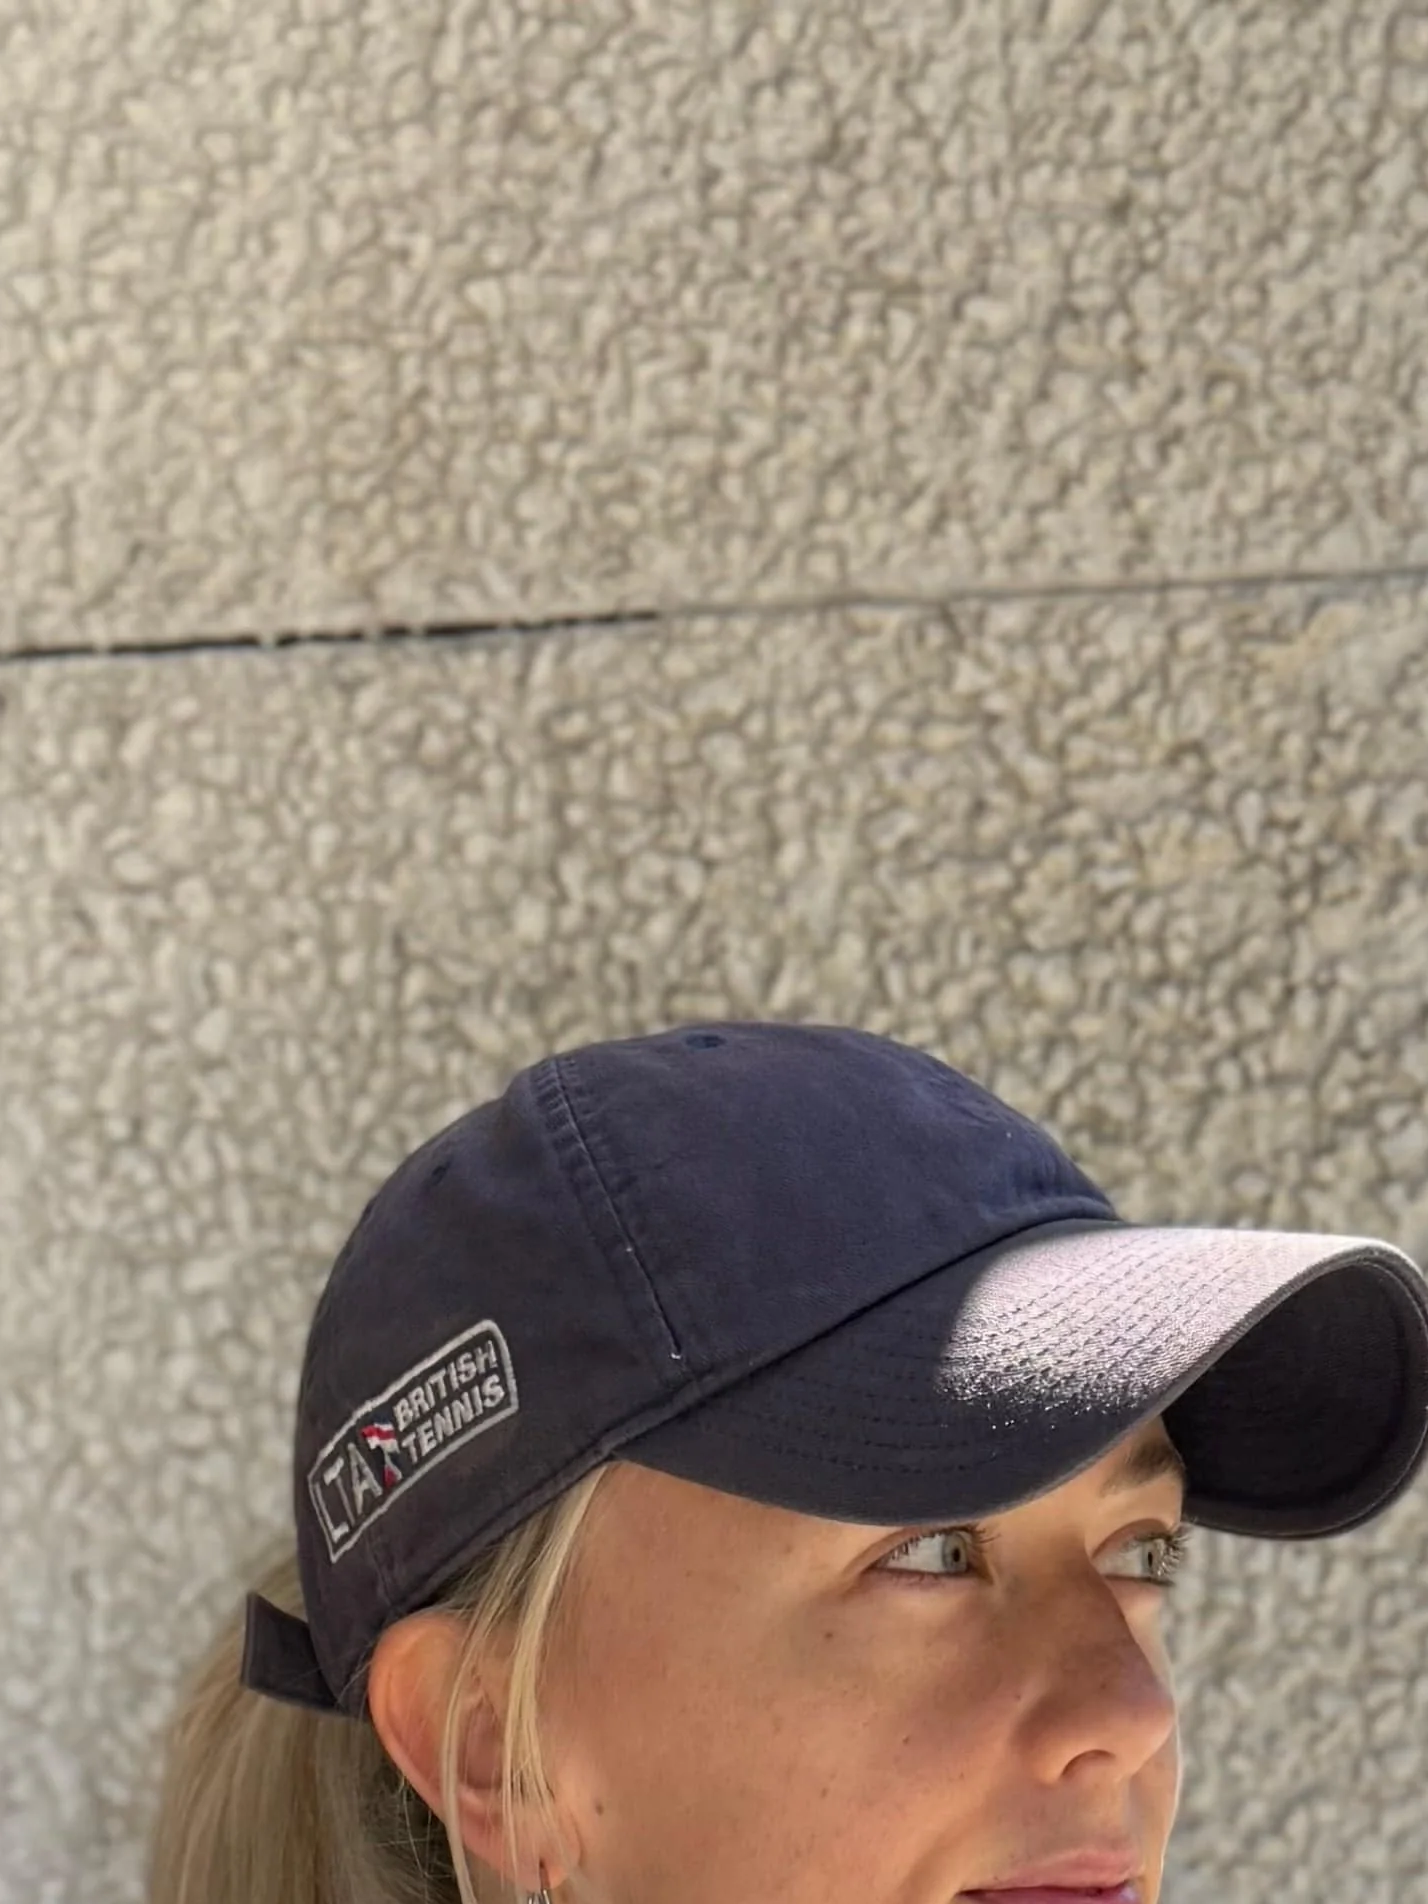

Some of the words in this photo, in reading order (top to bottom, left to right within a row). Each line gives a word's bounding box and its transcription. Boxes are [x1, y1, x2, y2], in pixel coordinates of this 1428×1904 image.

[392, 1339, 499, 1432] BRITISH
[401, 1374, 505, 1463] TENNIS
[314, 1442, 383, 1544] LTA
